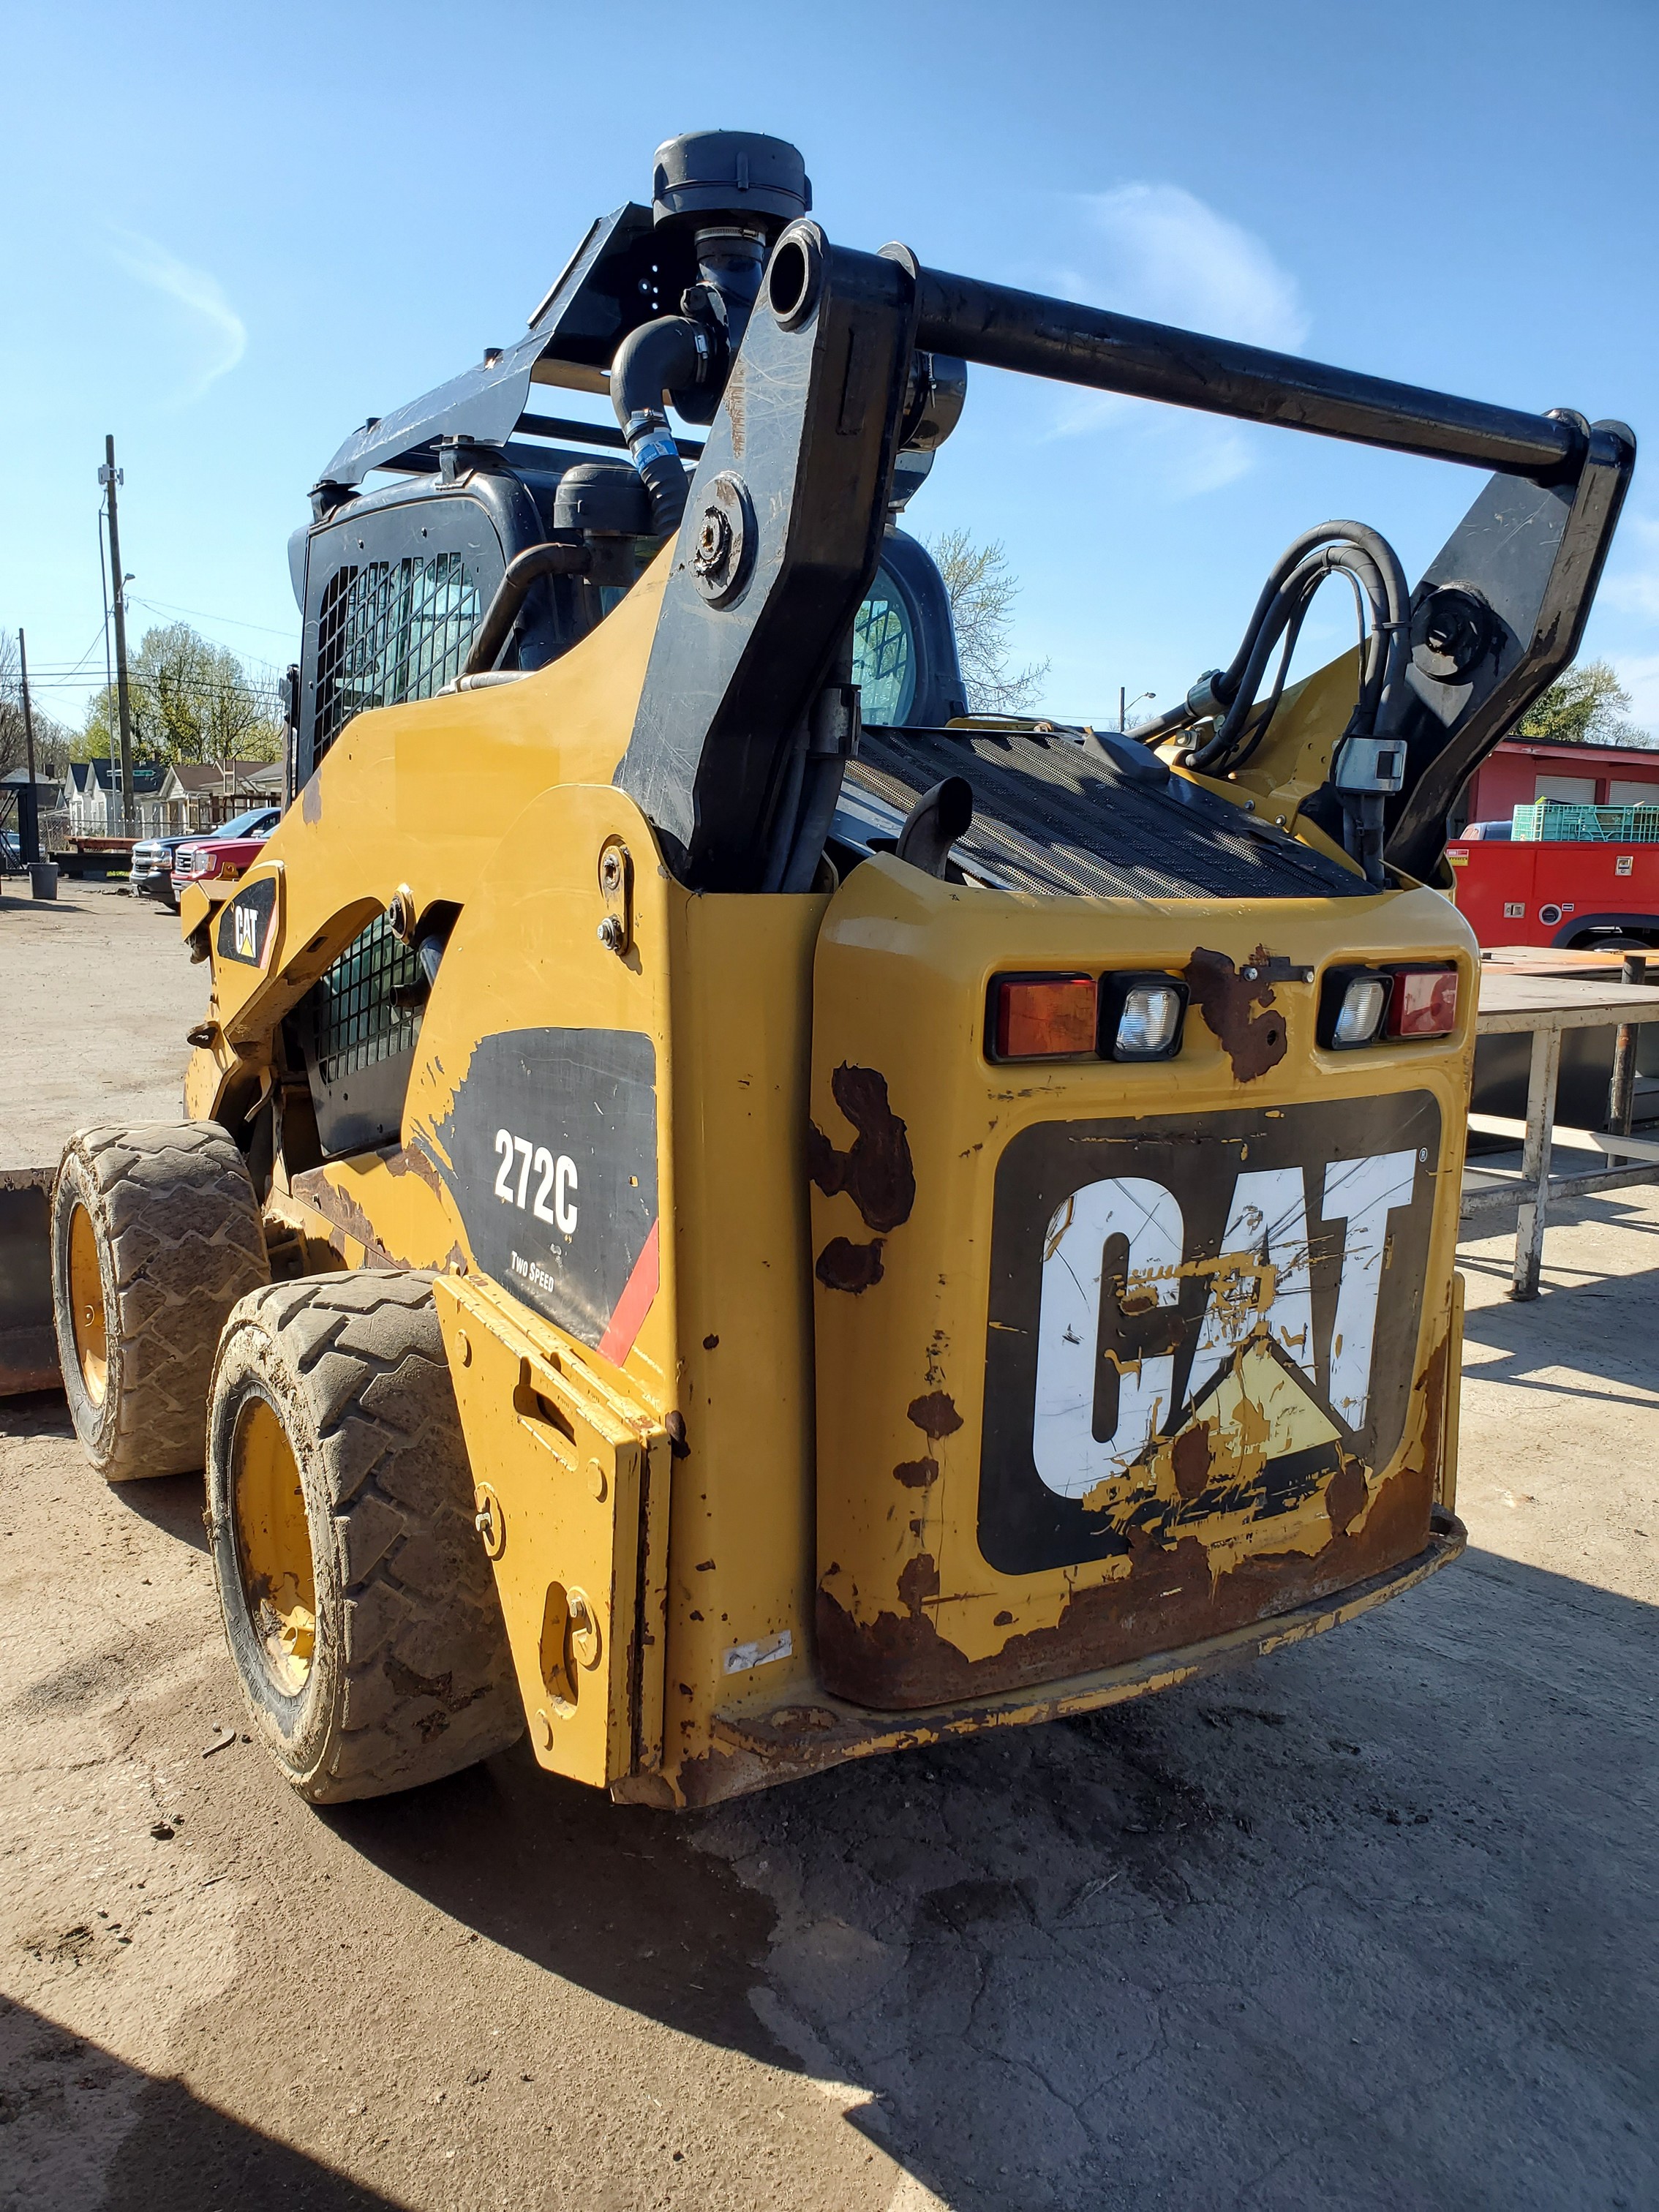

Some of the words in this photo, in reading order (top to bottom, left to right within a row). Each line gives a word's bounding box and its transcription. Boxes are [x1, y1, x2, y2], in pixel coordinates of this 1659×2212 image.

[235, 906, 257, 958] CAT
[494, 1128, 579, 1235] 272C
[511, 1250, 528, 1277] TWO
[529, 1262, 554, 1293] SPEED
[1032, 1148, 1418, 1500] CAT
